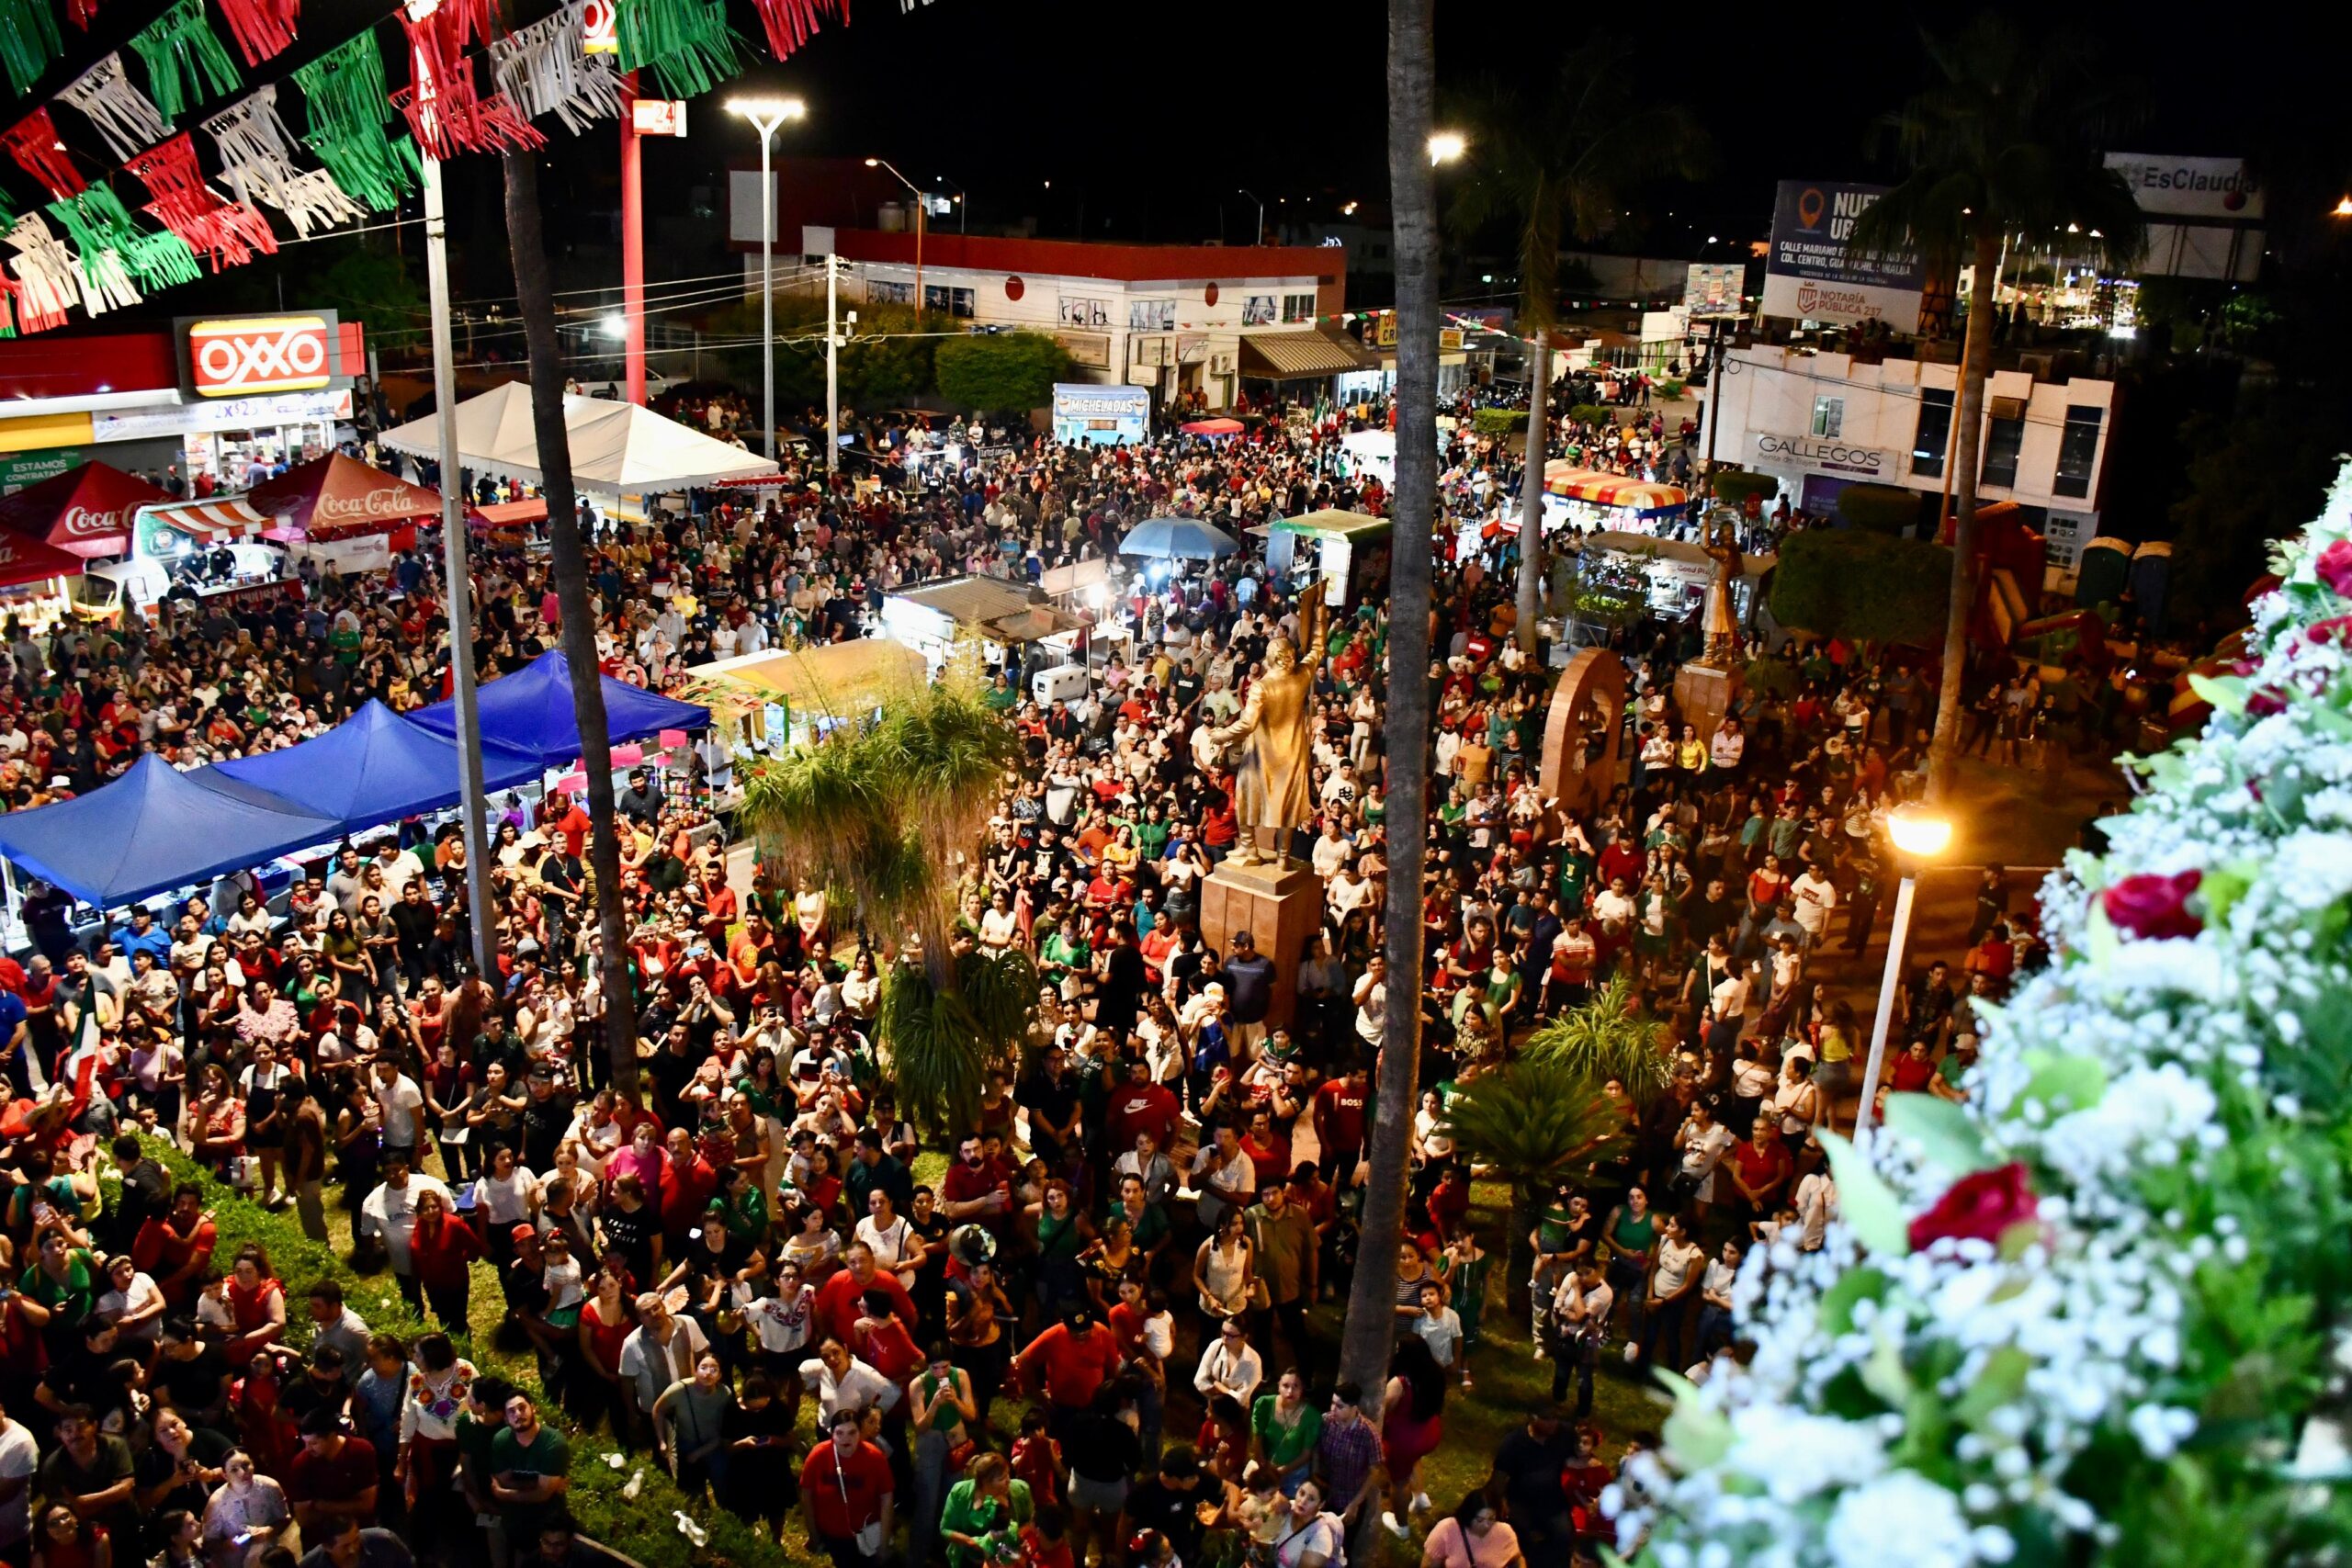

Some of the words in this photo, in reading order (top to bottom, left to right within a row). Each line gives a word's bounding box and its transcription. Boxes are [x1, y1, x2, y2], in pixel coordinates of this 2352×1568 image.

[1780, 241, 1802, 253] CALLE
[1803, 243, 1837, 256] MARIANO
[1819, 290, 1866, 304] NOTARÍA
[1818, 300, 1861, 315] PÚBLICA
[1863, 306, 1883, 317] 237
[199, 329, 324, 383] OXXO
[1069, 399, 1134, 413] MICHELADAS
[1759, 436, 1881, 467] GALLEGOS
[12, 459, 66, 472] ESTAMOS
[321, 485, 413, 520] Coca-Cola
[1678, 565, 1697, 574] Good
[1340, 1098, 1363, 1106] BOSS
